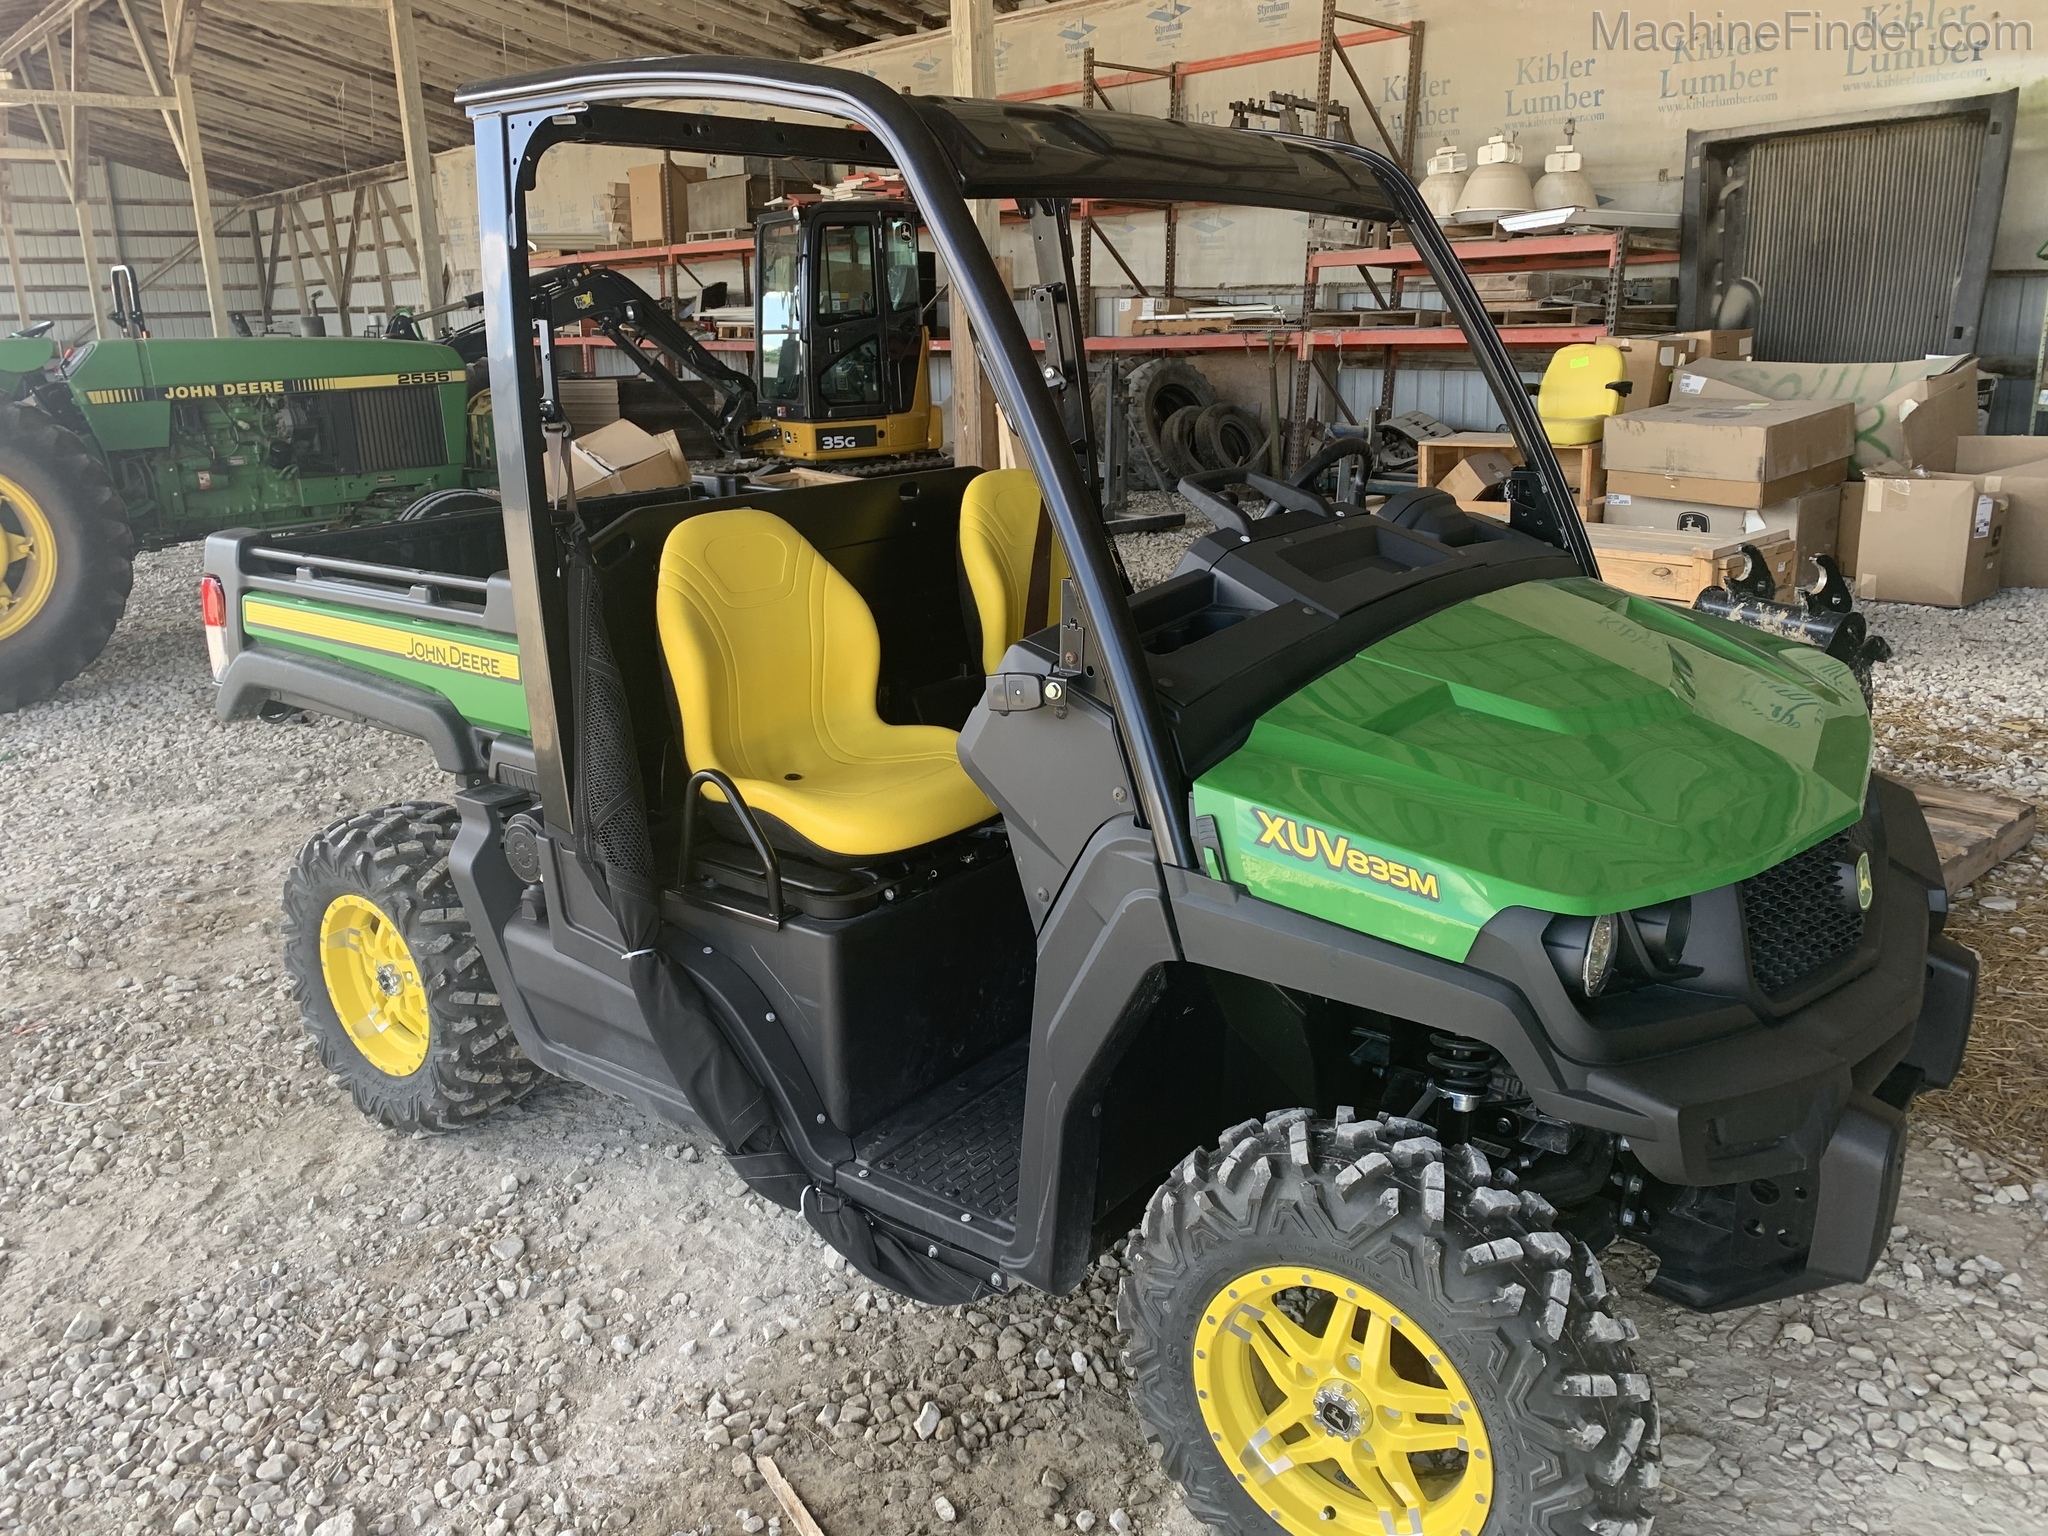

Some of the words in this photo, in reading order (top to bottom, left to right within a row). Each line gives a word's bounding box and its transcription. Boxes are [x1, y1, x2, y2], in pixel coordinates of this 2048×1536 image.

[1257, 2, 1290, 16] Styrofoam
[1861, 0, 1976, 39] Kibler
[1672, 28, 1768, 65] Kibler
[1845, 30, 1988, 77] Lumber
[1516, 50, 1596, 86] Kibler
[1659, 59, 1779, 99] Lumber
[1842, 66, 1988, 93] www.kiblerlumber.com
[1382, 70, 1451, 103] Kiler
[1505, 82, 1605, 117] Lumber
[1657, 91, 1779, 114] www.kiblerlumber.com
[164, 384, 217, 400] JOHN
[222, 380, 285, 396] DEERE
[397, 371, 450, 385] 2555
[822, 435, 856, 449] 35G
[407, 637, 446, 663] JOHN
[449, 646, 500, 675] DEERE
[1251, 807, 1442, 903] XUV835M
